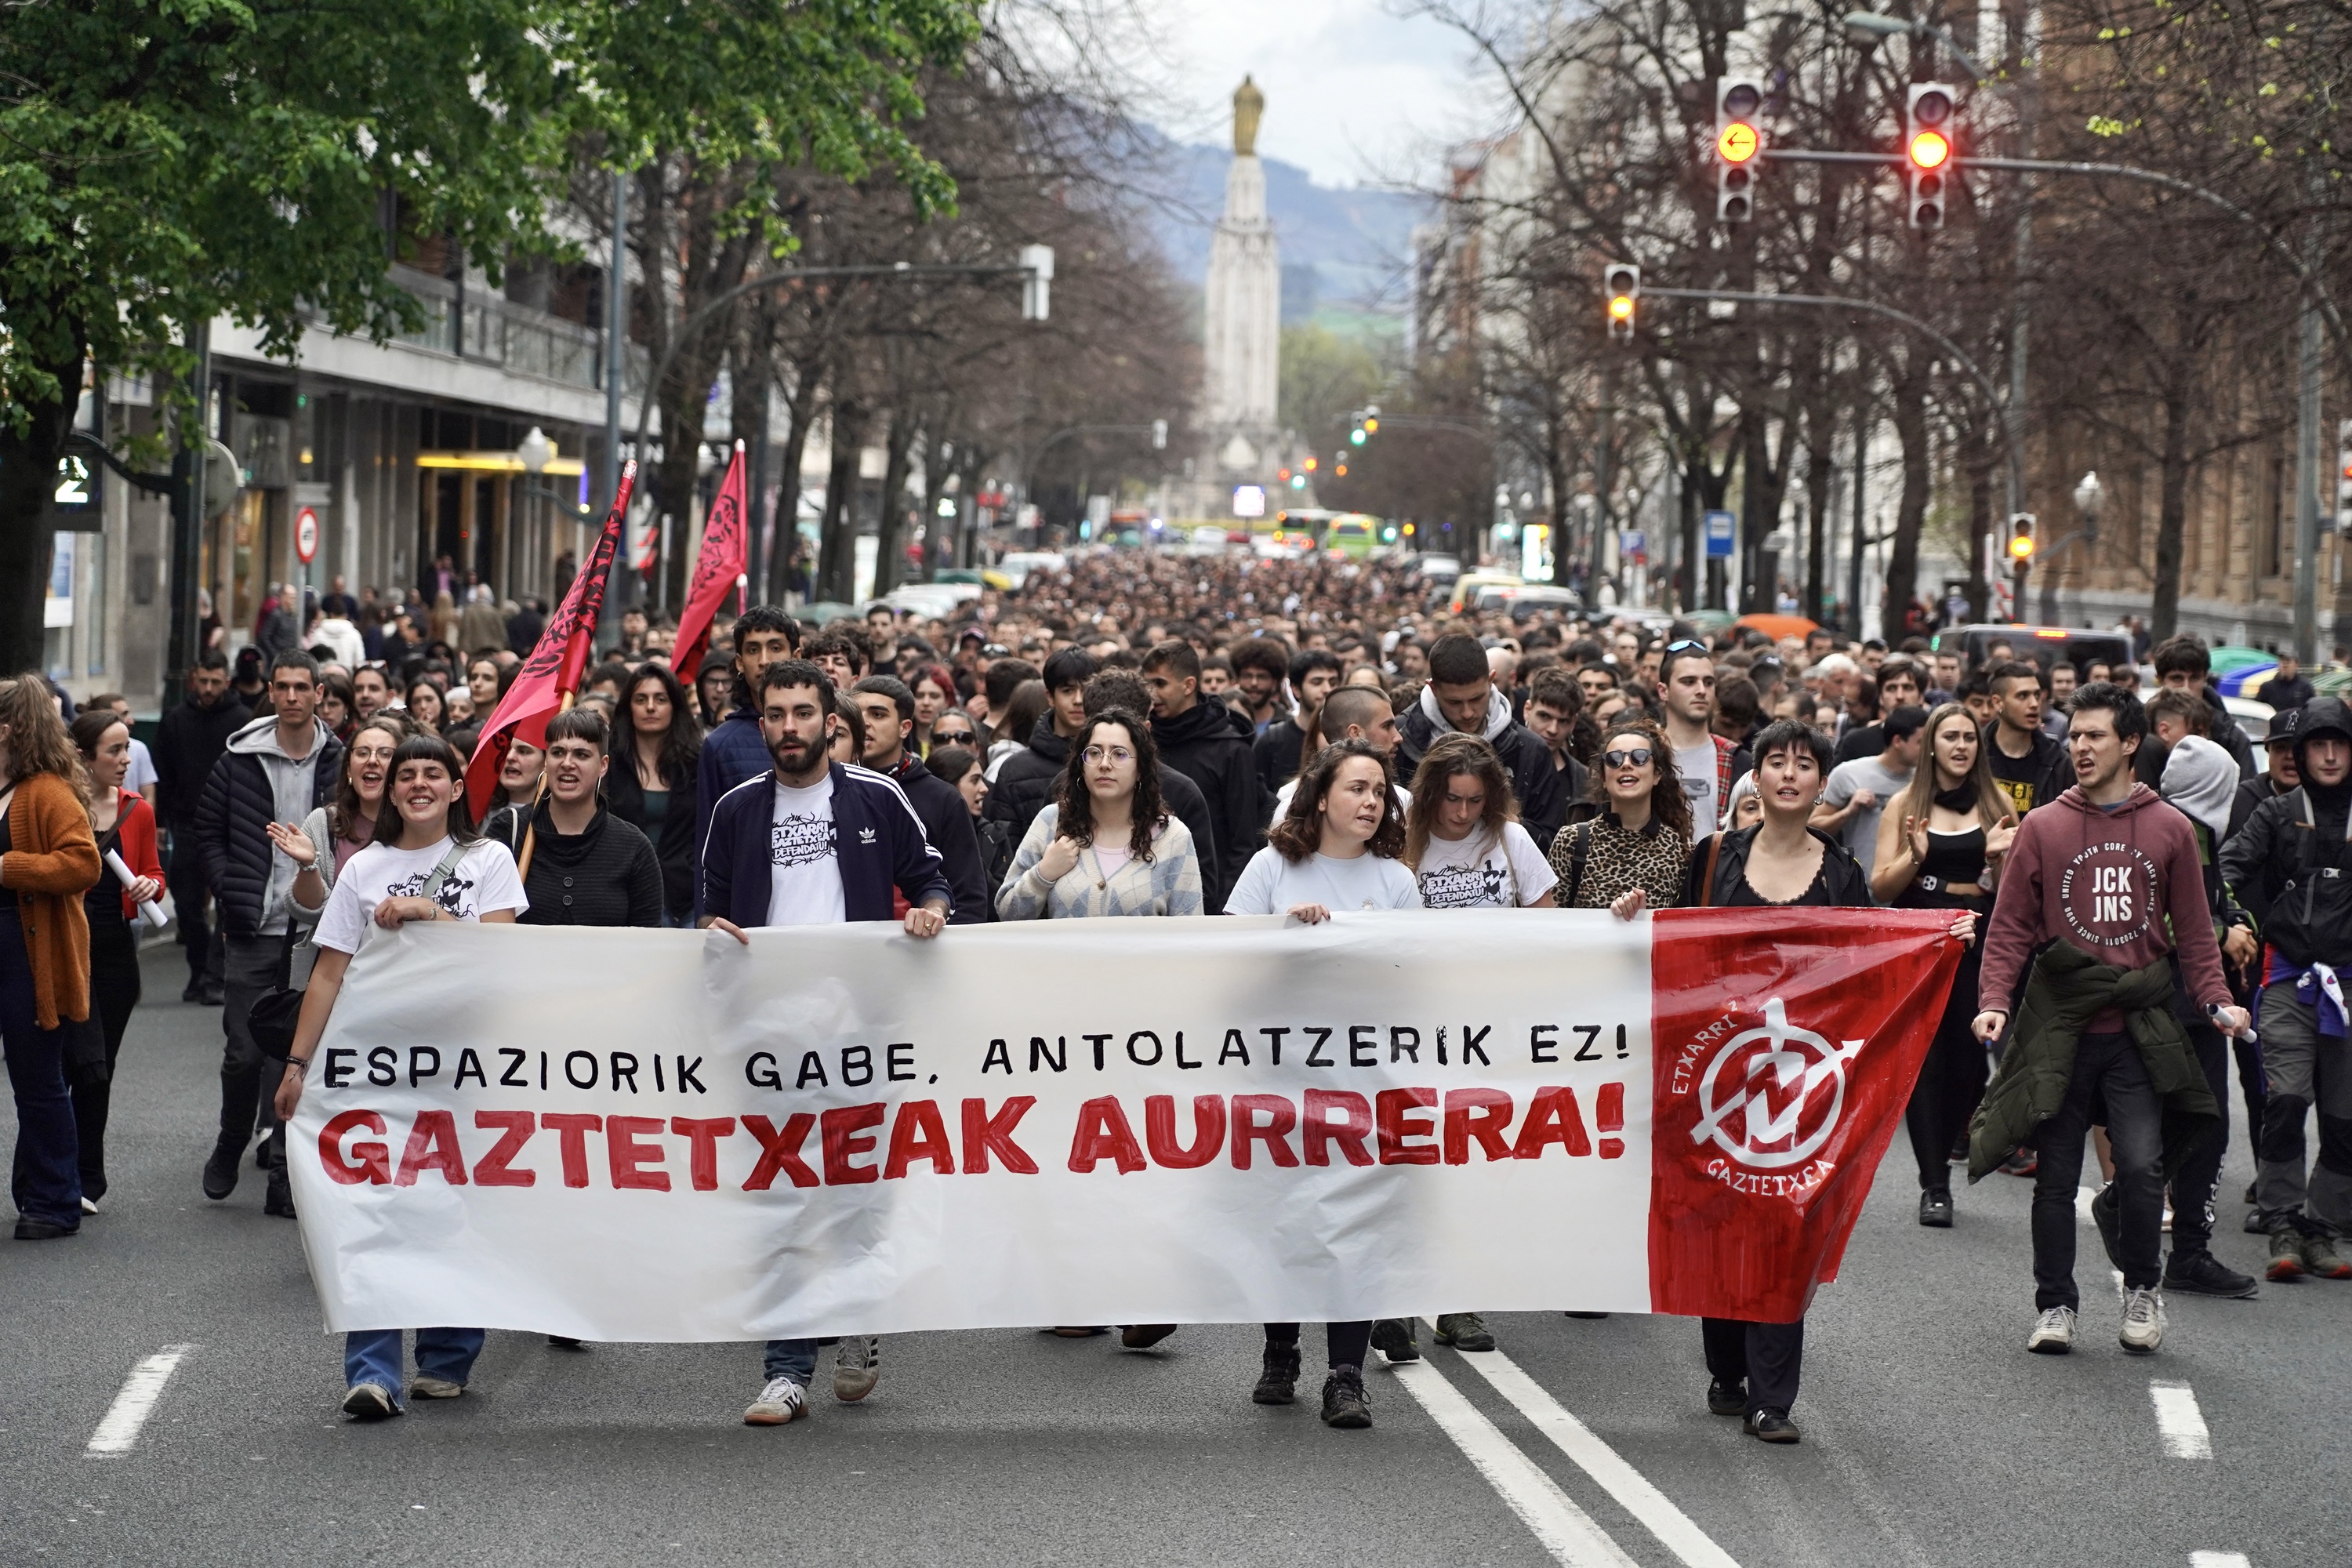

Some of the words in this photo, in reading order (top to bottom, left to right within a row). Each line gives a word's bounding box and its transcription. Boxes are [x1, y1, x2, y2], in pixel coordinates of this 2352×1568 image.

[55, 456, 89, 503] 2
[771, 821, 829, 839] ETXARRI
[772, 832, 830, 849] GAZTETXEA
[774, 841, 828, 858] DEFENDATU!
[2104, 842, 2126, 852] CORE
[1427, 871, 1484, 887] ETXARRI
[2143, 860, 2156, 879] JACK
[1426, 880, 1487, 895] GAZTETXEA
[2061, 869, 2074, 898] UNITED
[2092, 866, 2132, 893] JCK
[1430, 887, 1484, 904] DEFENDATU!
[2064, 906, 2078, 926] 1990
[2092, 895, 2132, 923] JNS
[2077, 925, 2100, 943] SINCE
[2106, 930, 2139, 946] 7203011
[324, 1046, 707, 1094] ESPAZIORIK
[981, 1025, 1492, 1075] ANTOLATZERIK
[1530, 1023, 1630, 1064] EZ!
[1671, 1014, 1738, 1094] ETXARRI
[318, 1095, 1040, 1192] GAZTETXEAK
[1067, 1081, 1625, 1176] AURRERA!
[1708, 1158, 1835, 1196] GAZTETXEA
